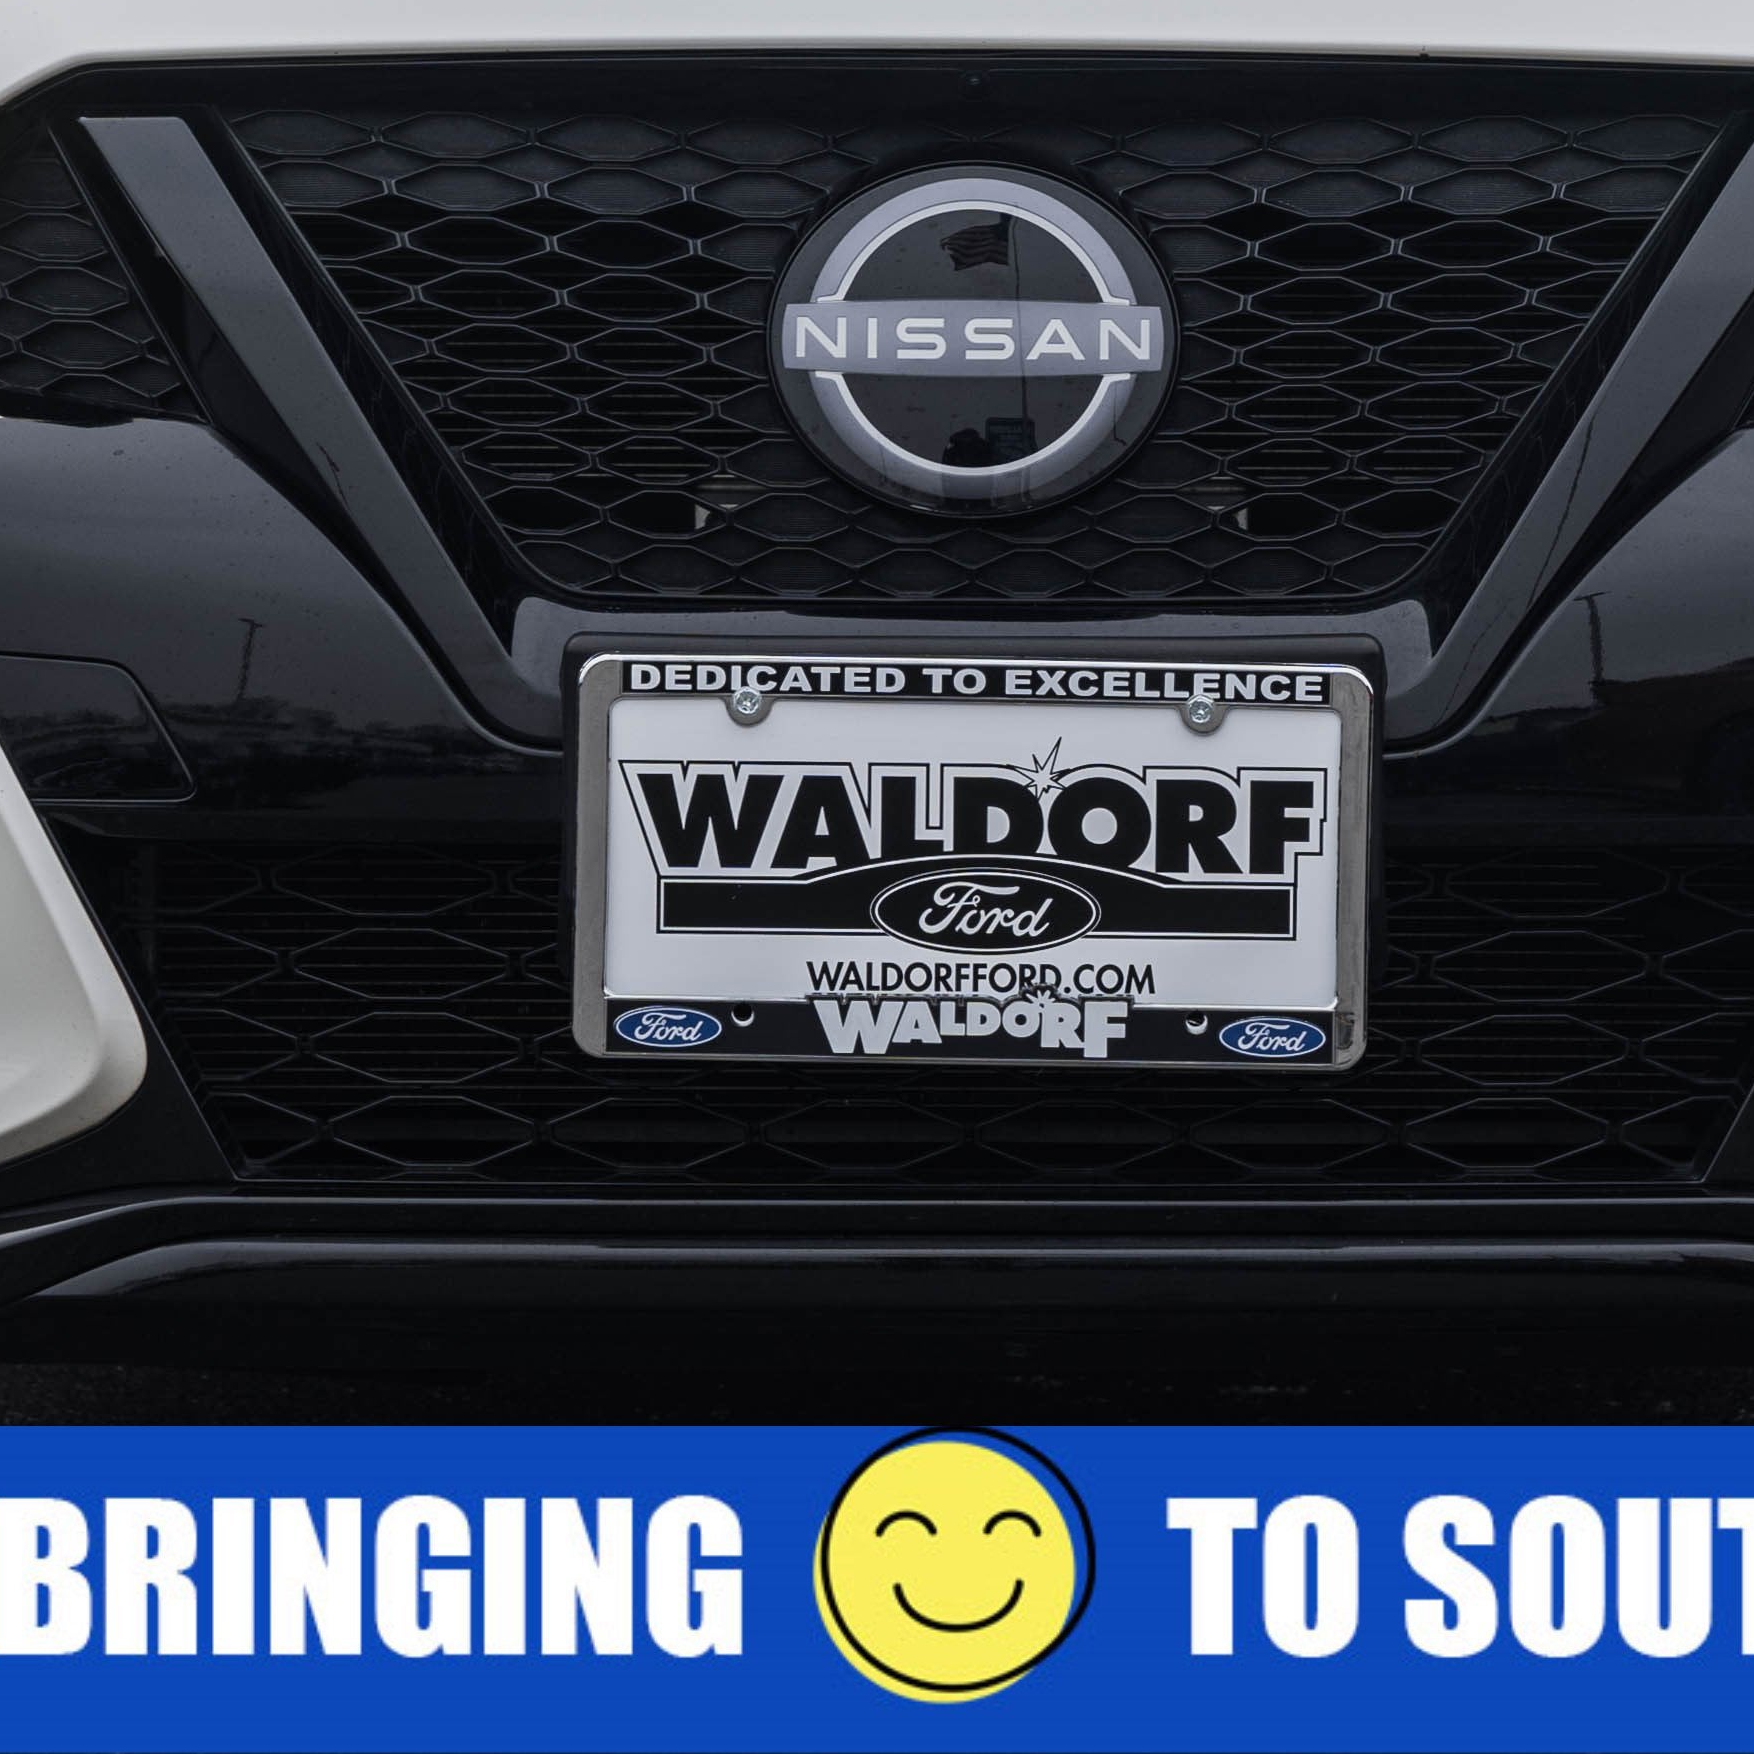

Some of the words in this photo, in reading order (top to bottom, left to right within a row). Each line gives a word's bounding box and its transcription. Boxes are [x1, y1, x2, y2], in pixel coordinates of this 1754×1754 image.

[796, 315, 1151, 360] NISSAN
[630, 664, 906, 694] DEDICATED
[922, 668, 986, 695] TO
[1005, 669, 1323, 702] EXCELLENCE
[636, 771, 1314, 876] WALDORF
[919, 881, 1053, 937] Ford
[806, 960, 1156, 996] WALDORFFORD.COM
[633, 1012, 703, 1044] Ford
[813, 999, 1129, 1059] WALDORF
[1238, 1020, 1307, 1054] Ford
